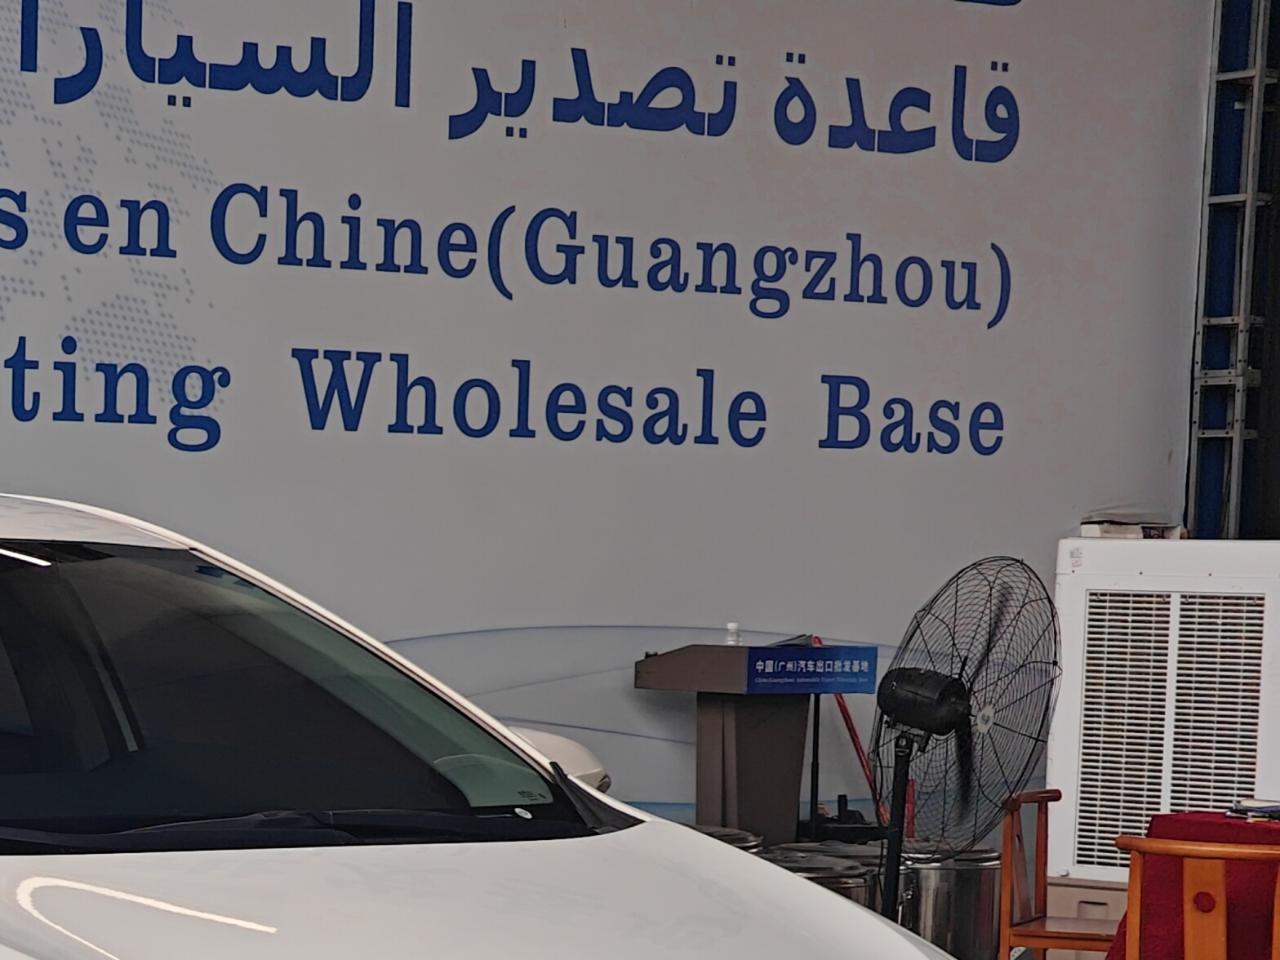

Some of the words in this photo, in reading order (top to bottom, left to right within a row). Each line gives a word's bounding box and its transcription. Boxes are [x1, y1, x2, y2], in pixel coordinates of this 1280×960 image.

[448, 48, 737, 140] تصدير
[774, 52, 1020, 164] قاعدة
[63, 195, 177, 258] en
[292, 347, 767, 449] Wholesale
[819, 375, 1005, 456] Base
